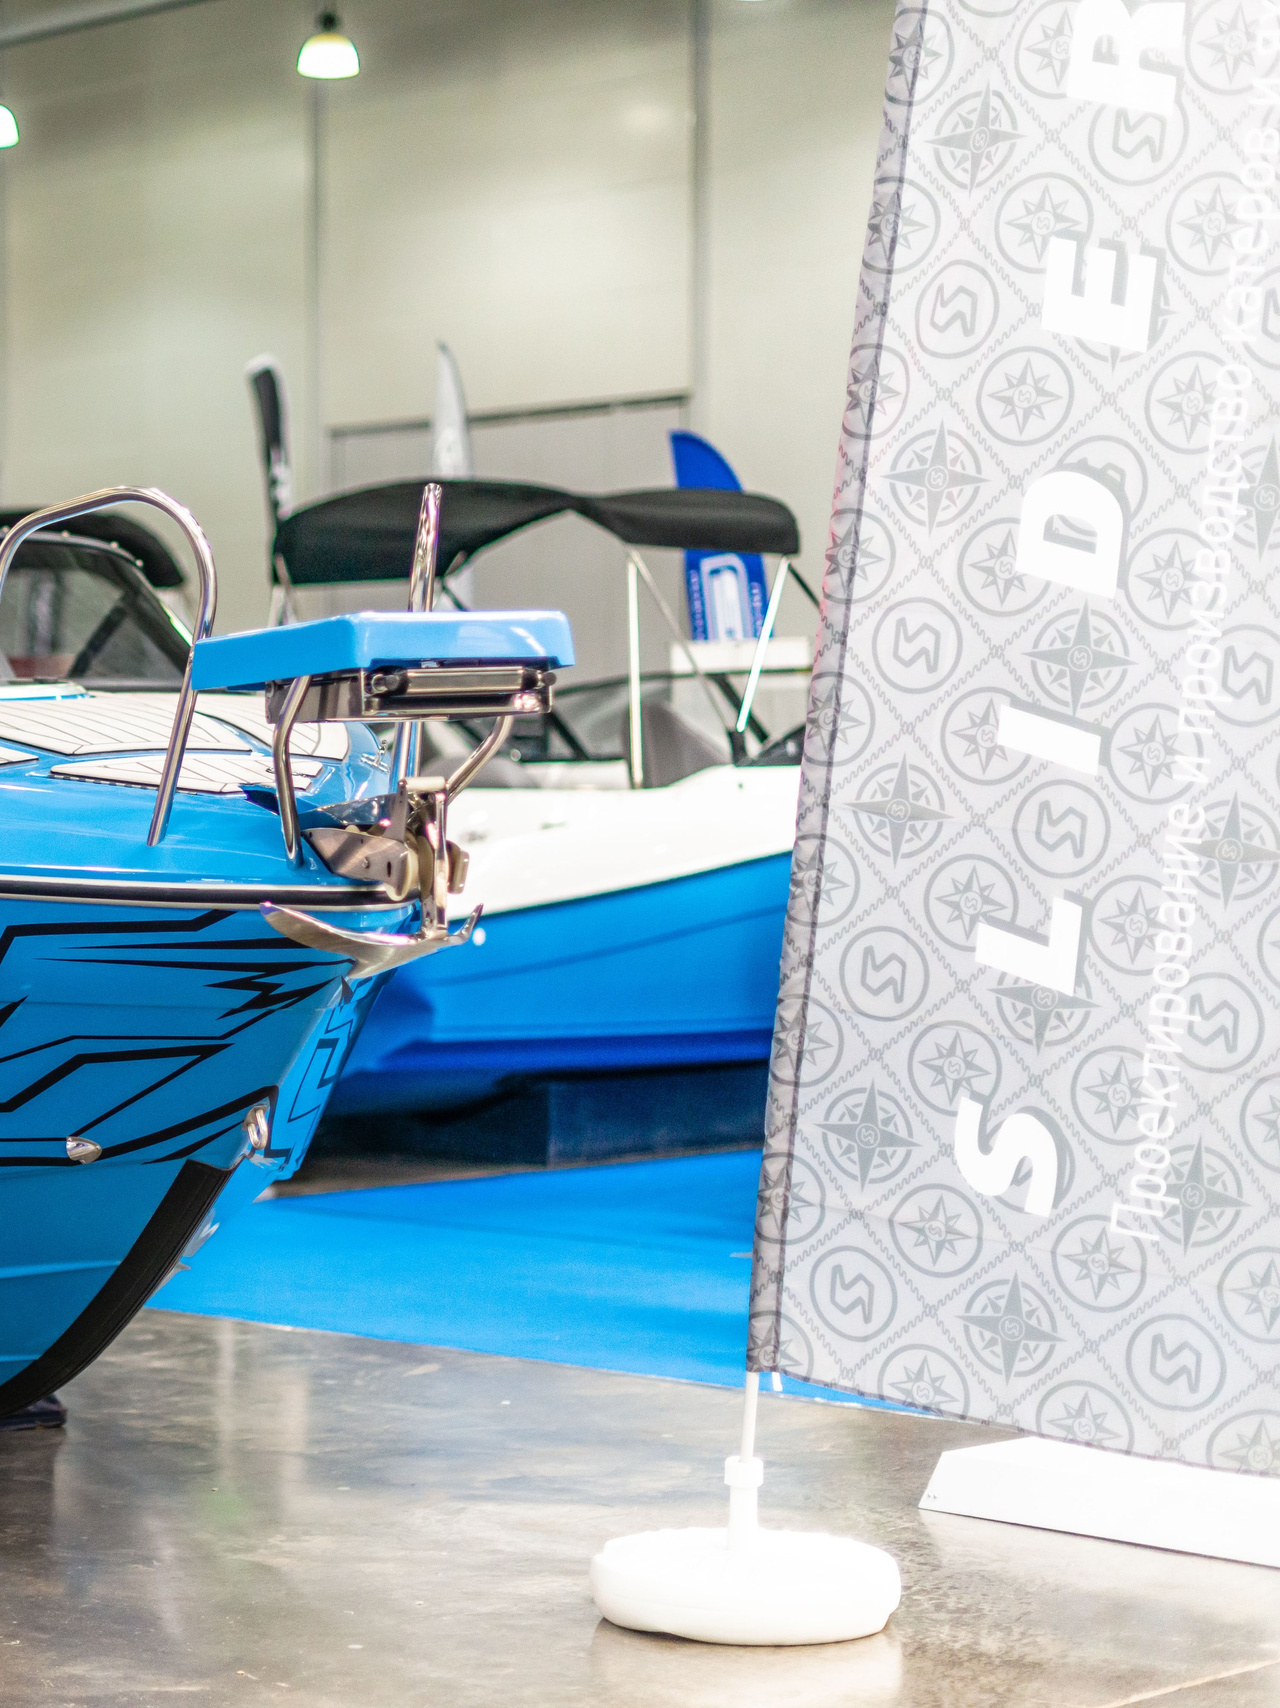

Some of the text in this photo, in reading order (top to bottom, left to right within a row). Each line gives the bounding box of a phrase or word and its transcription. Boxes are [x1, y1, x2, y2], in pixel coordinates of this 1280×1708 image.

[1221, 128, 1280, 343] катеров
[955, 0, 1188, 1217] SLIDER
[1177, 363, 1253, 735] производство
[1173, 755, 1211, 783] и
[1110, 803, 1206, 1241] Проектирование
